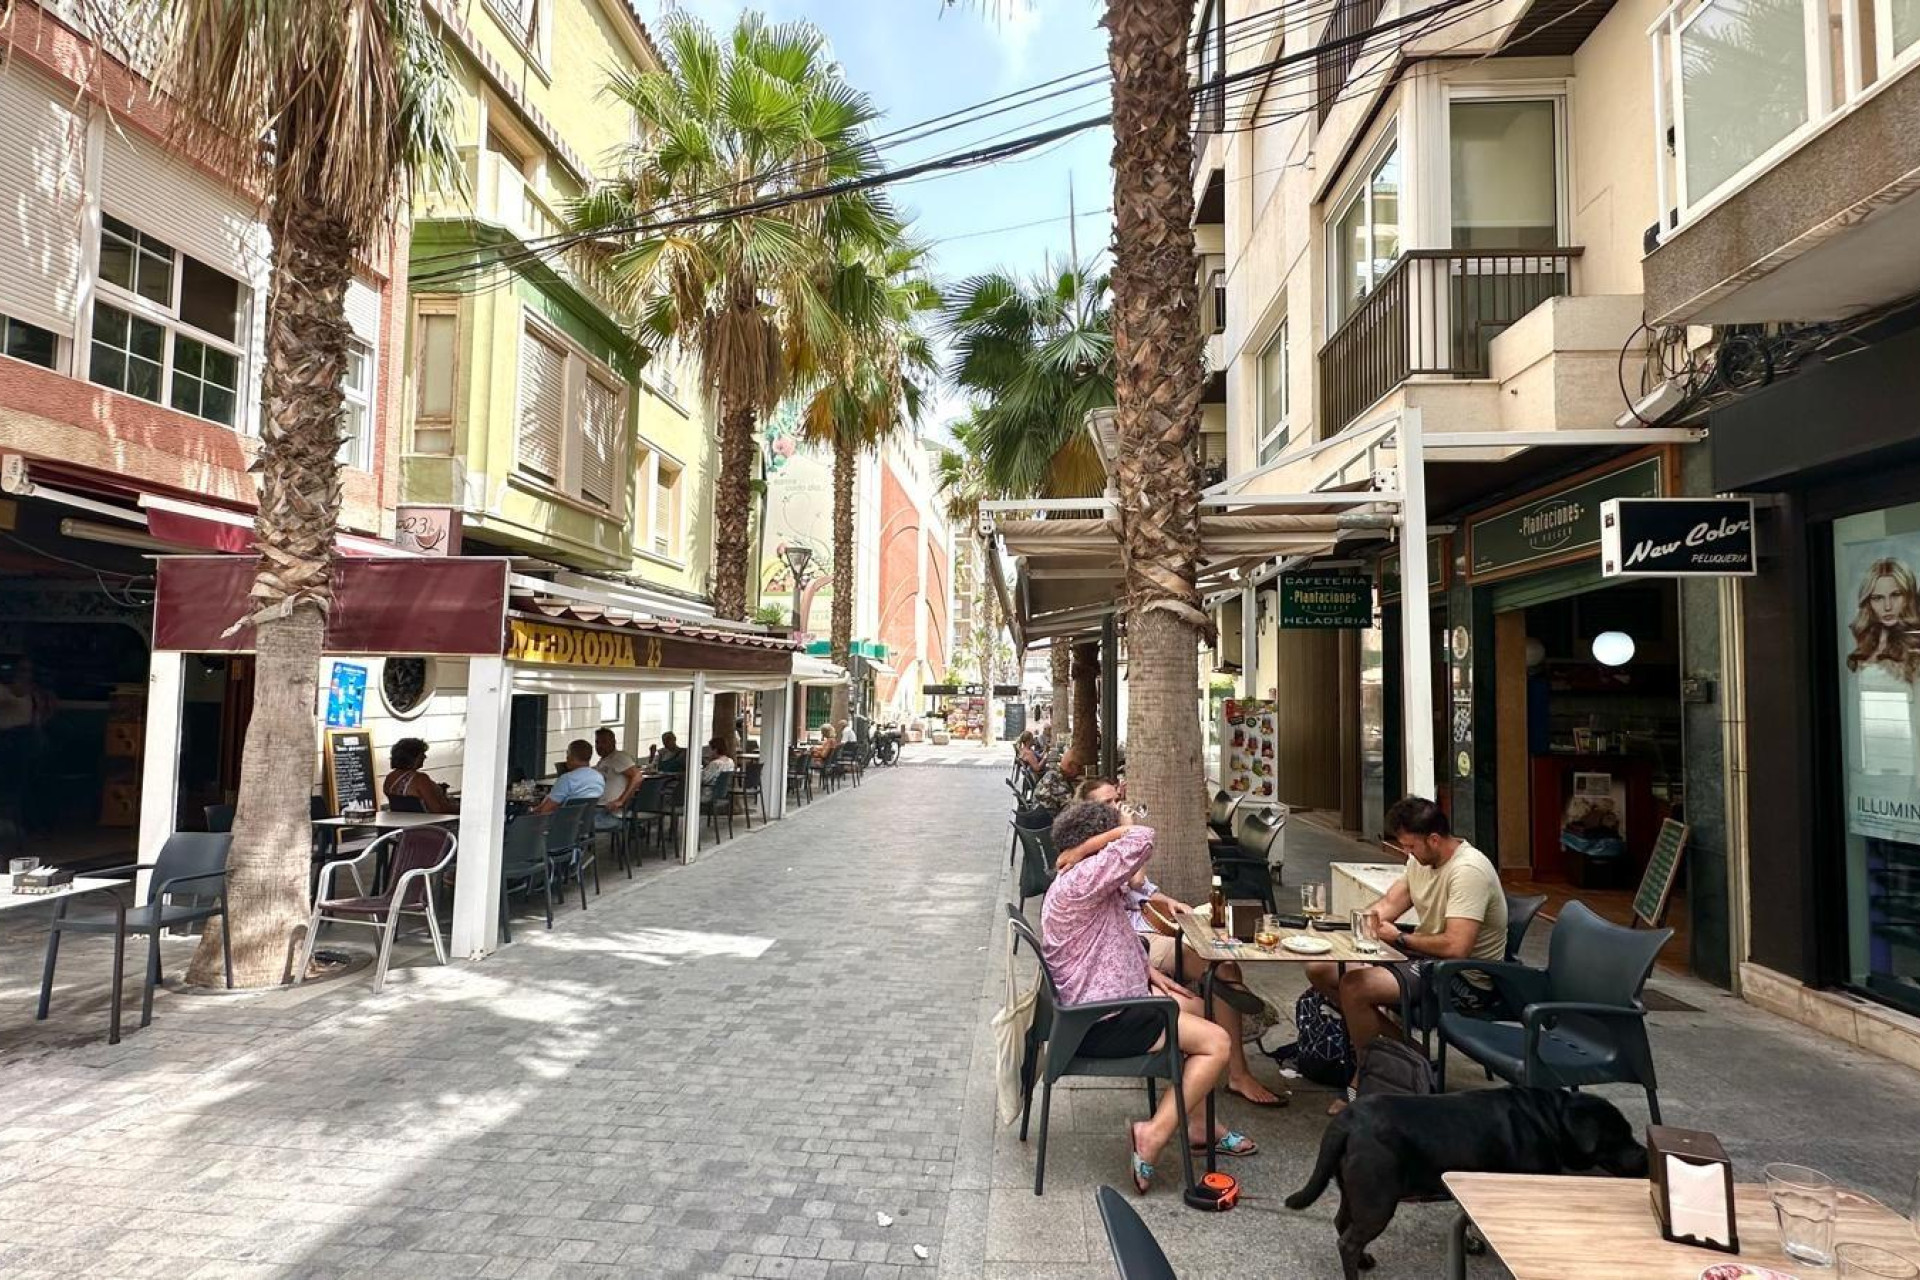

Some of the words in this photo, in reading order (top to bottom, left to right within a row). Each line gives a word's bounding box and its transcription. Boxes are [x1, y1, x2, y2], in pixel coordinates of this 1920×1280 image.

[1522, 502, 1581, 536] Plantaciones
[1624, 539, 1681, 566] New
[1685, 516, 1750, 546] Color
[1691, 553, 1747, 563] PELUQUERIA
[1285, 577, 1367, 585] CAFETERIA
[1294, 589, 1357, 604] Plantaciones
[1284, 616, 1368, 625] HELADERIA
[507, 620, 636, 668] MEDIODIA
[647, 637, 663, 668] 23
